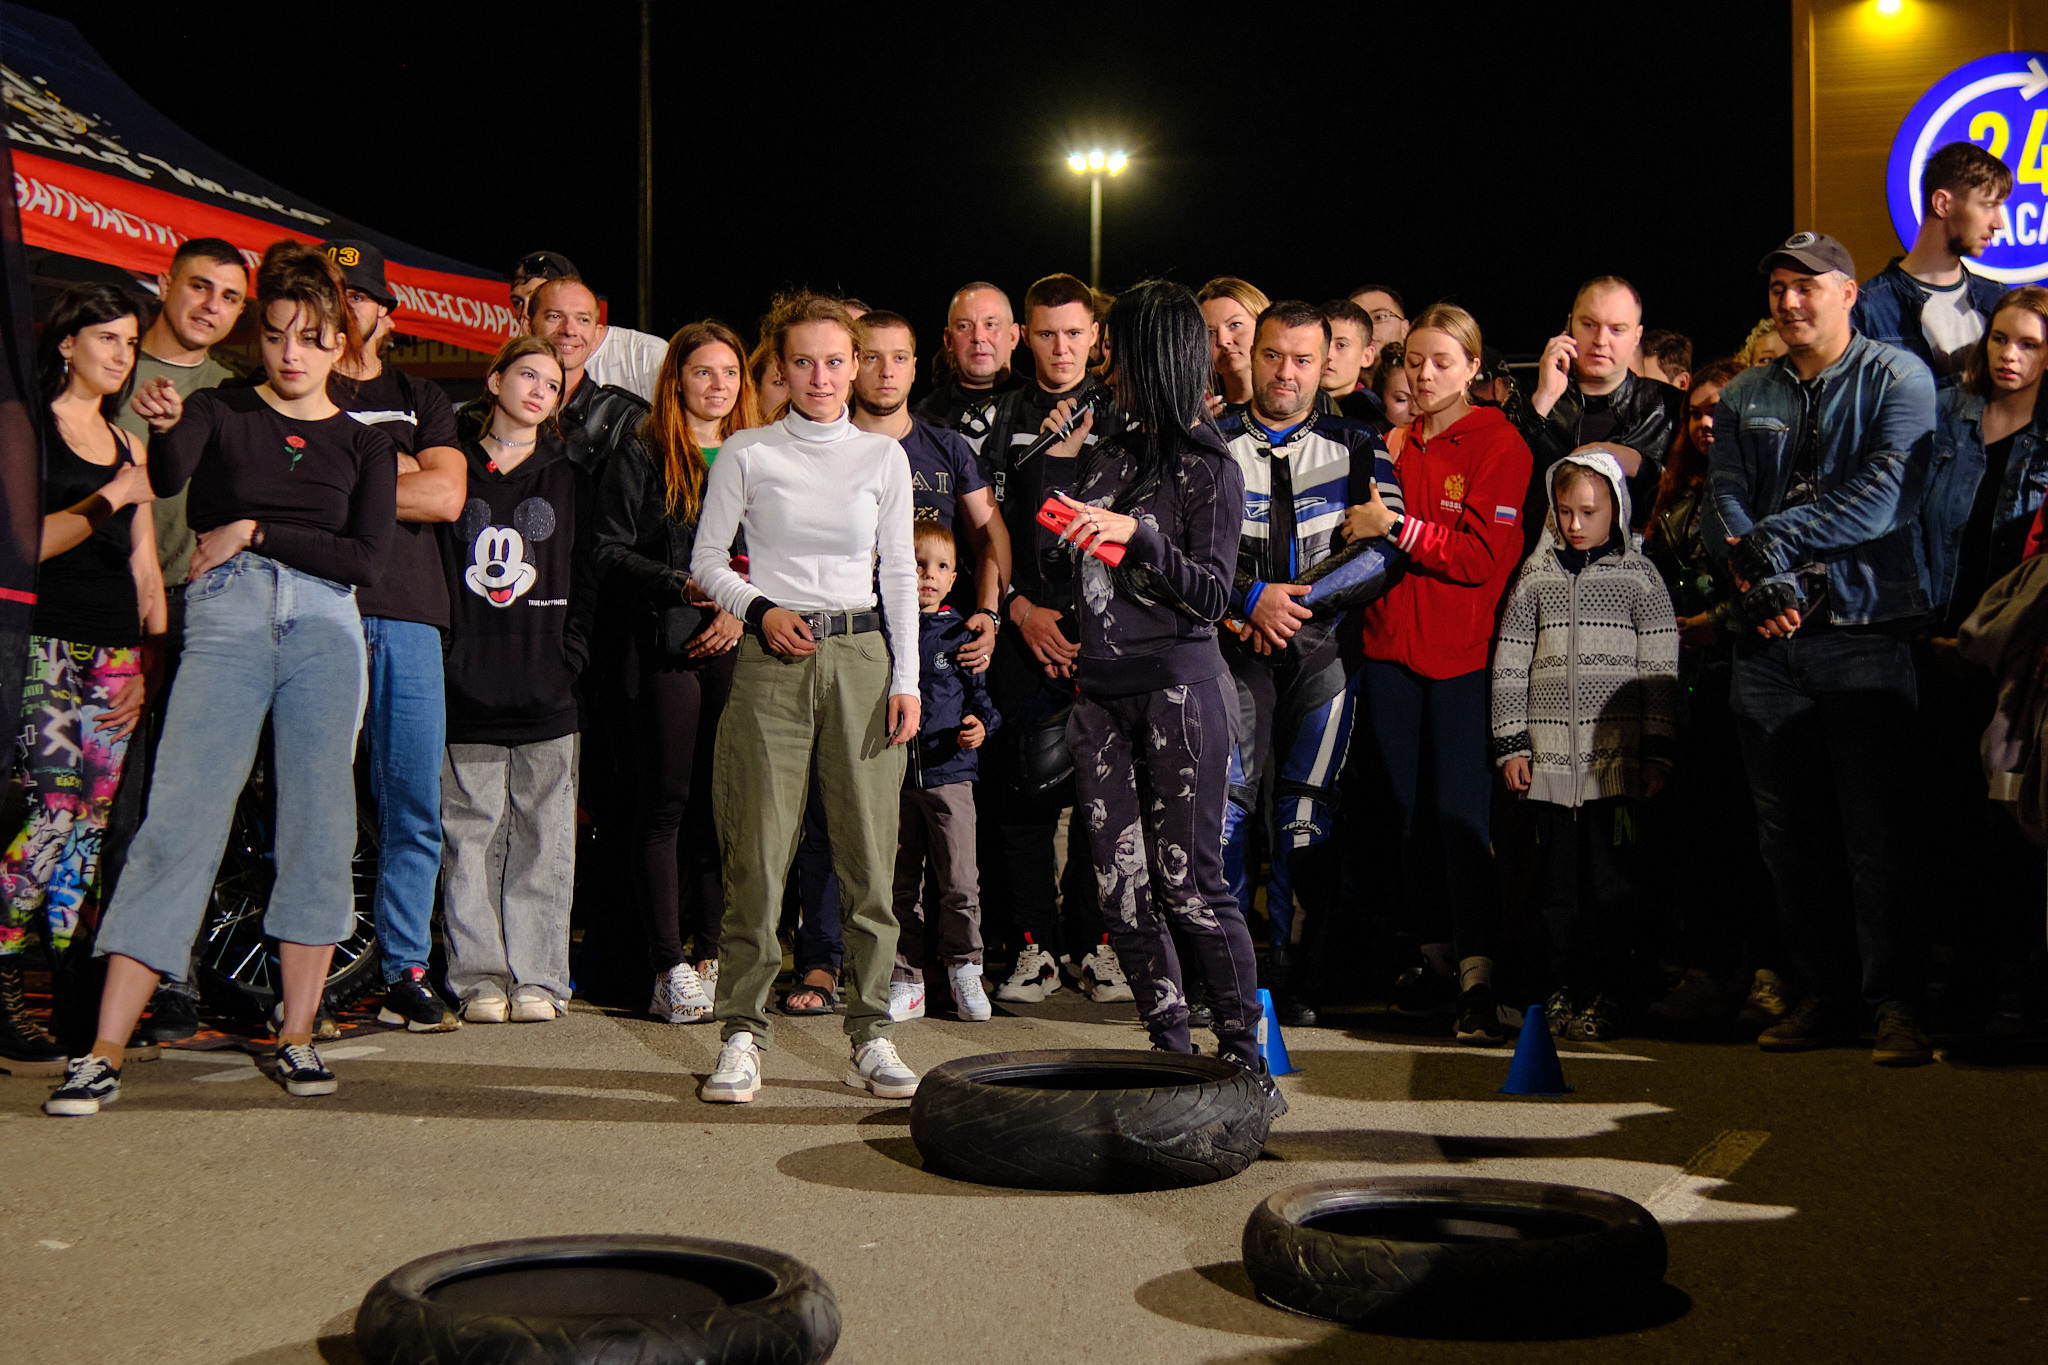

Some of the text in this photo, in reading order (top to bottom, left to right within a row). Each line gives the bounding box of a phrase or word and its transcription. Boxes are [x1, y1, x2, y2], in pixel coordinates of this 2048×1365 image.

[1969, 109, 2048, 196] 24
[528, 598, 568, 607] TRUE HAPPINESS
